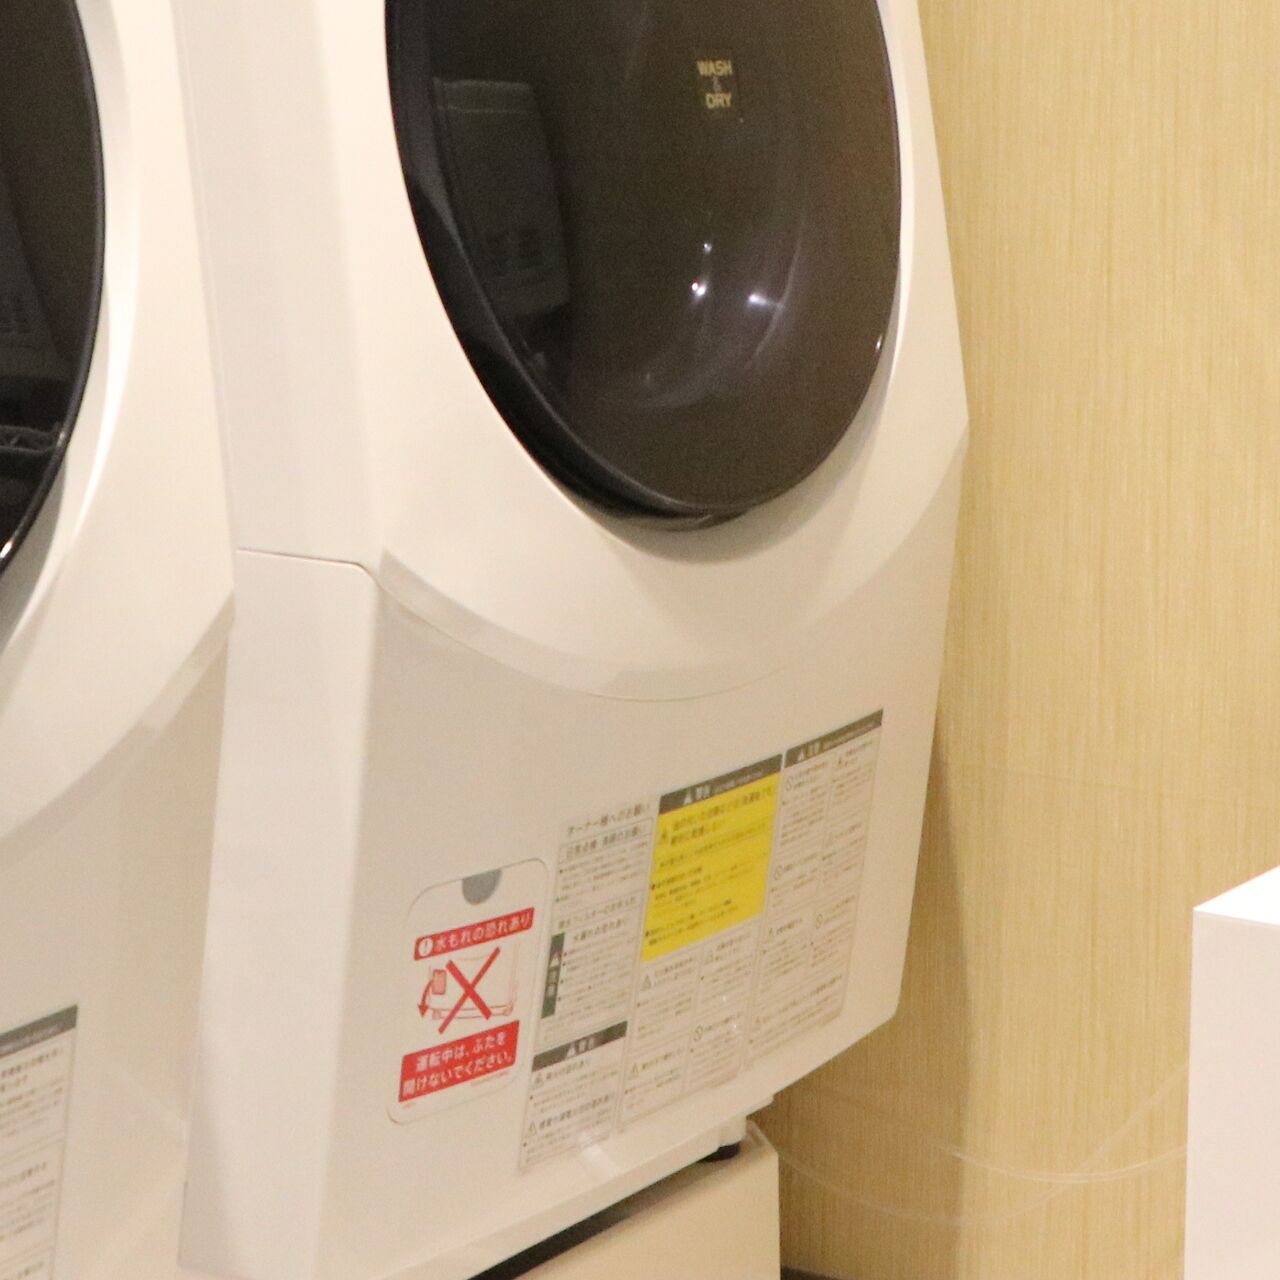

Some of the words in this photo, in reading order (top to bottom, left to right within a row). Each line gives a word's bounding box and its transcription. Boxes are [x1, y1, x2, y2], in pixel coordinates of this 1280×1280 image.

[696, 59, 733, 76] WASH
[705, 90, 732, 109] DRY
[434, 911, 531, 949] 水もれの恐れあり
[415, 1031, 507, 1072] 運転中は、ふたを
[402, 1050, 513, 1096] 開けないでください。
